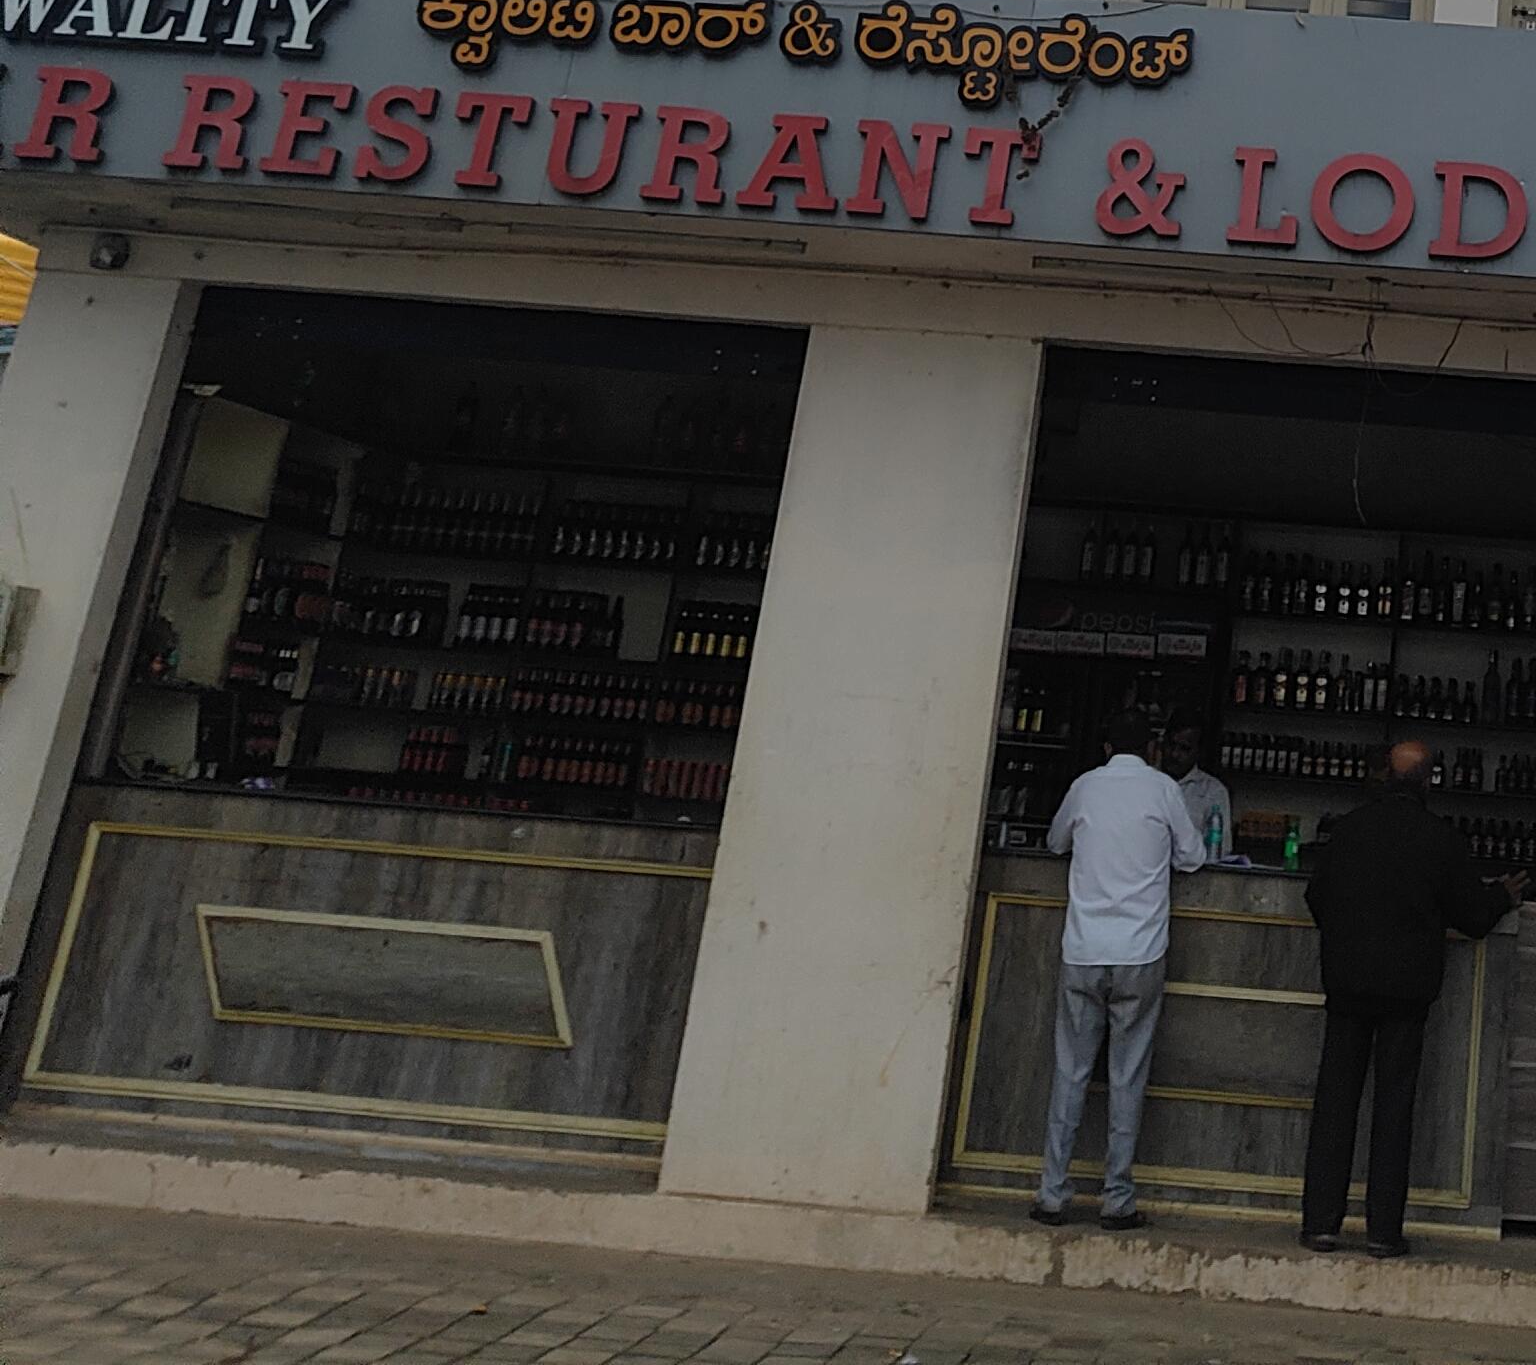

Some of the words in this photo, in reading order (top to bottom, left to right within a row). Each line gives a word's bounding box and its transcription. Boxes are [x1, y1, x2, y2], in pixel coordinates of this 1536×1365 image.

[614, 0, 767, 50] ಬಾರ್
[784, 4, 837, 58] &
[162, 73, 1041, 226] RESTURANT
[1095, 137, 1187, 237] &
[1080, 611, 1155, 634] pepsi
